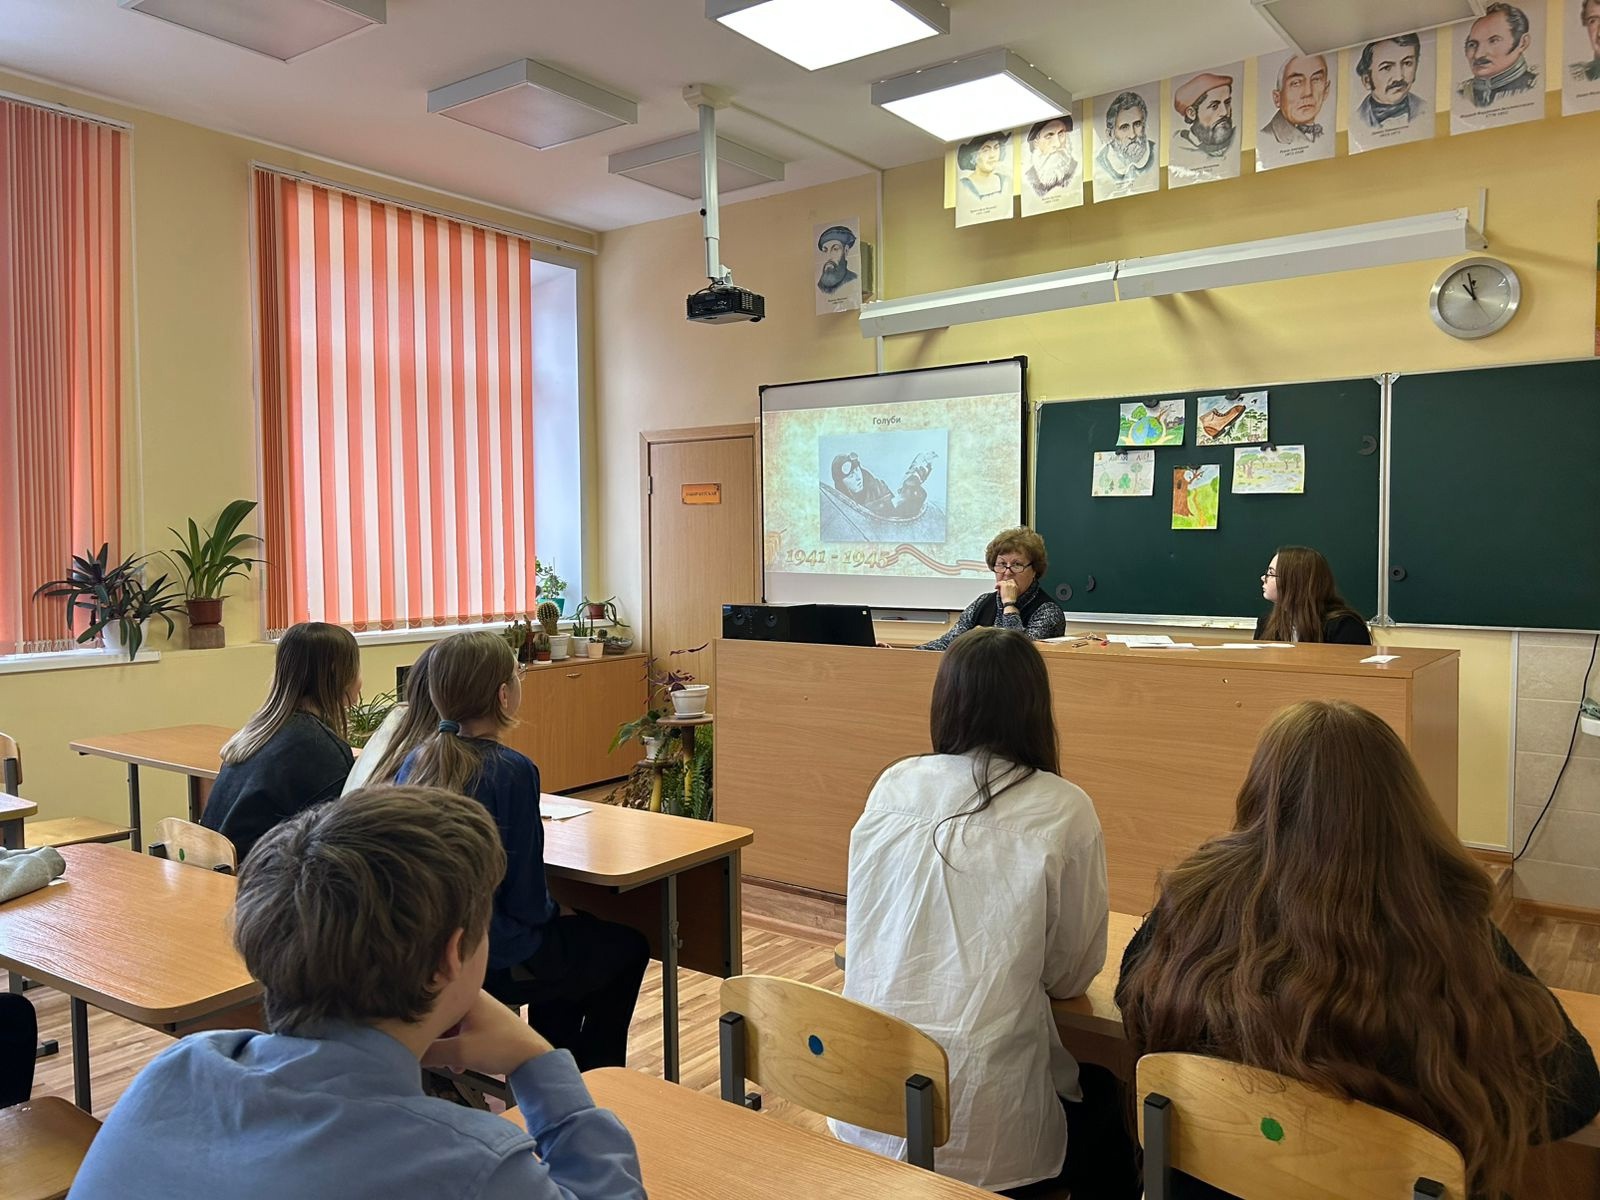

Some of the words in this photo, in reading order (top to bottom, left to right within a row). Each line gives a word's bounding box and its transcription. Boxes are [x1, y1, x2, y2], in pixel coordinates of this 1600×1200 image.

[872, 415, 901, 426] Голуби
[785, 548, 826, 567] 1941
[842, 549, 890, 569] 1945
